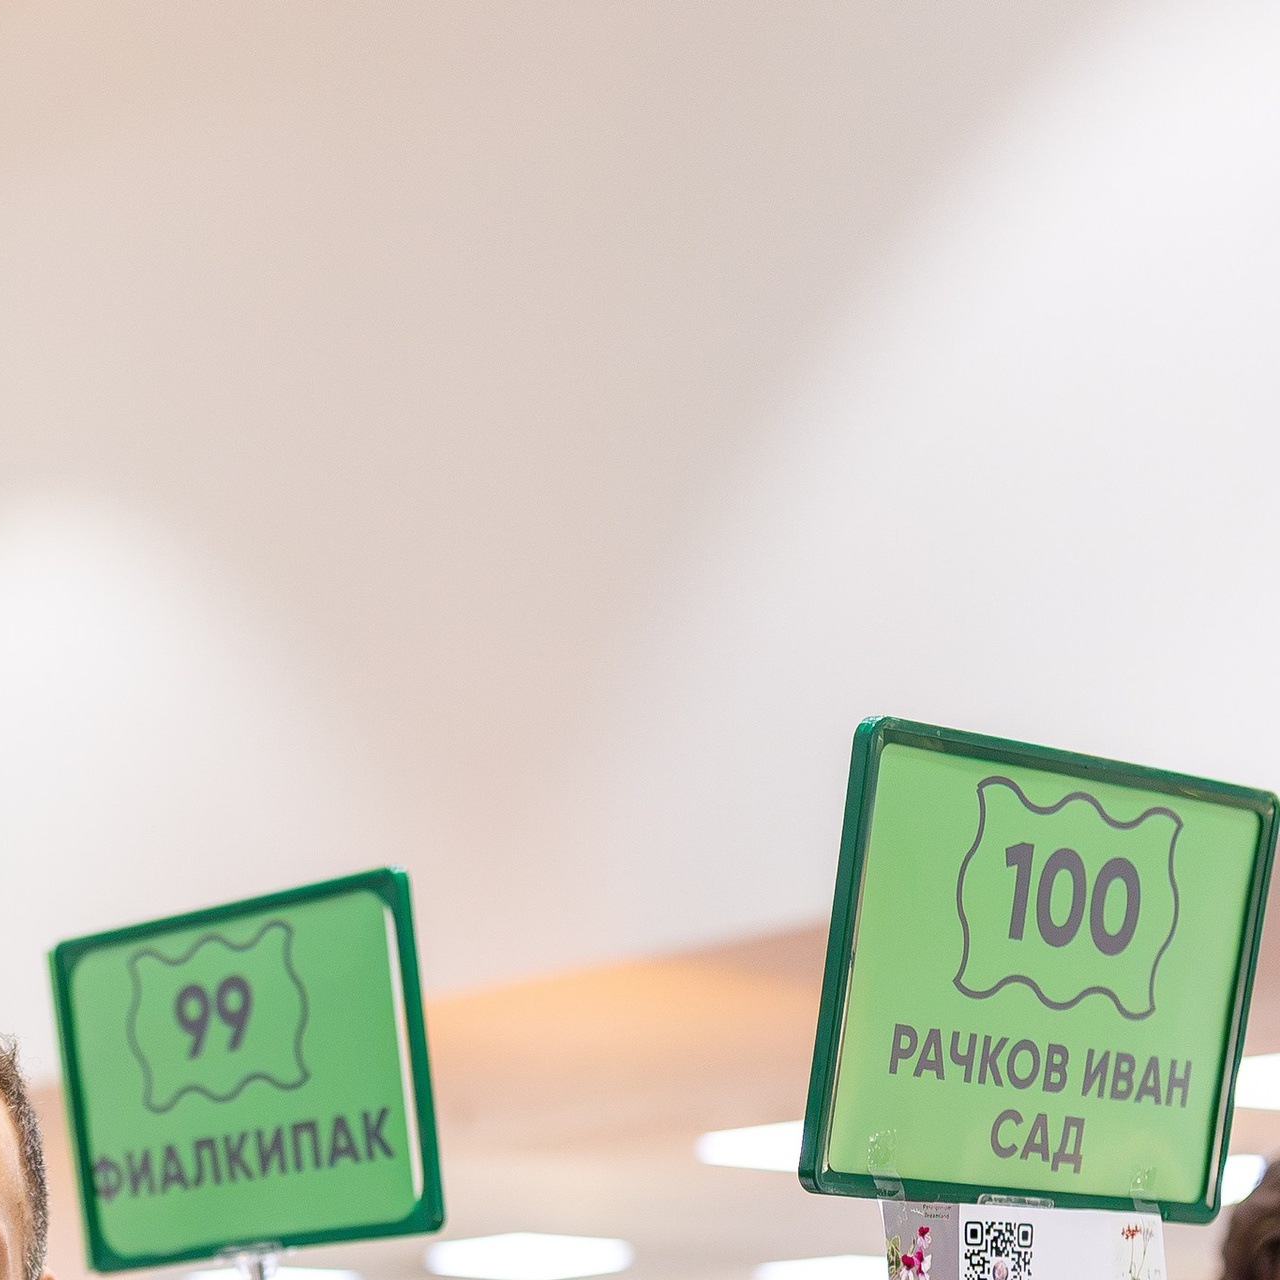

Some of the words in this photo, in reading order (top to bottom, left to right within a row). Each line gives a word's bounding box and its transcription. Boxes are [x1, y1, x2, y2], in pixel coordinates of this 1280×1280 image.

[1005, 842, 1141, 956] 100
[174, 975, 252, 1060] 99
[889, 1023, 1069, 1093] РАЧКОВ
[1081, 1048, 1192, 1109] ИВАН
[990, 1109, 1085, 1174] САД
